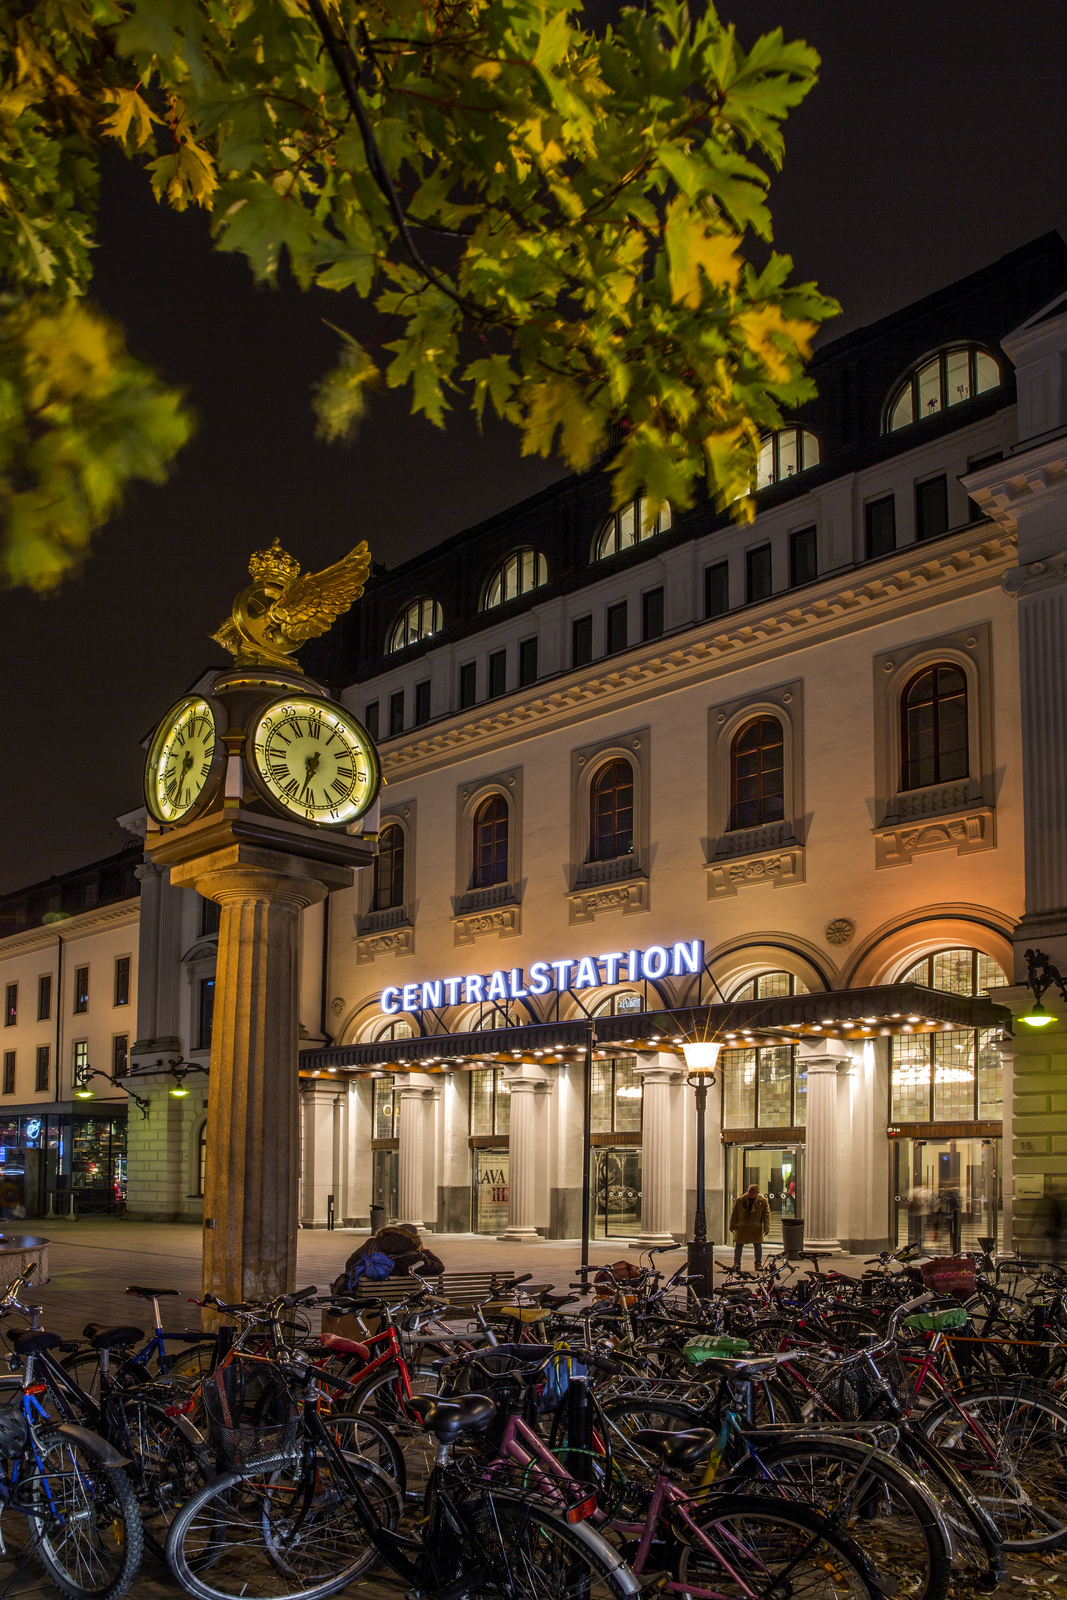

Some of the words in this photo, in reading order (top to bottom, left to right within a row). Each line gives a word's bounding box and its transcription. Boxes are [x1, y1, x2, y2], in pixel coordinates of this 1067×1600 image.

[281, 706, 296, 718] 23
[309, 707, 322, 719] 24
[261, 718, 275, 731] 22
[334, 722, 345, 733] 13
[255, 743, 264, 755] 21
[351, 746, 362, 756] 14
[261, 769, 271, 783] 20
[358, 772, 366, 782] 15
[279, 794, 289, 804] 19
[349, 795, 360, 806] 16
[305, 809, 315, 819] 18
[330, 808, 339, 819] 17
[380, 939, 705, 1015] CENTRALSTATION
[1020, 1142, 1032, 1150] 15
